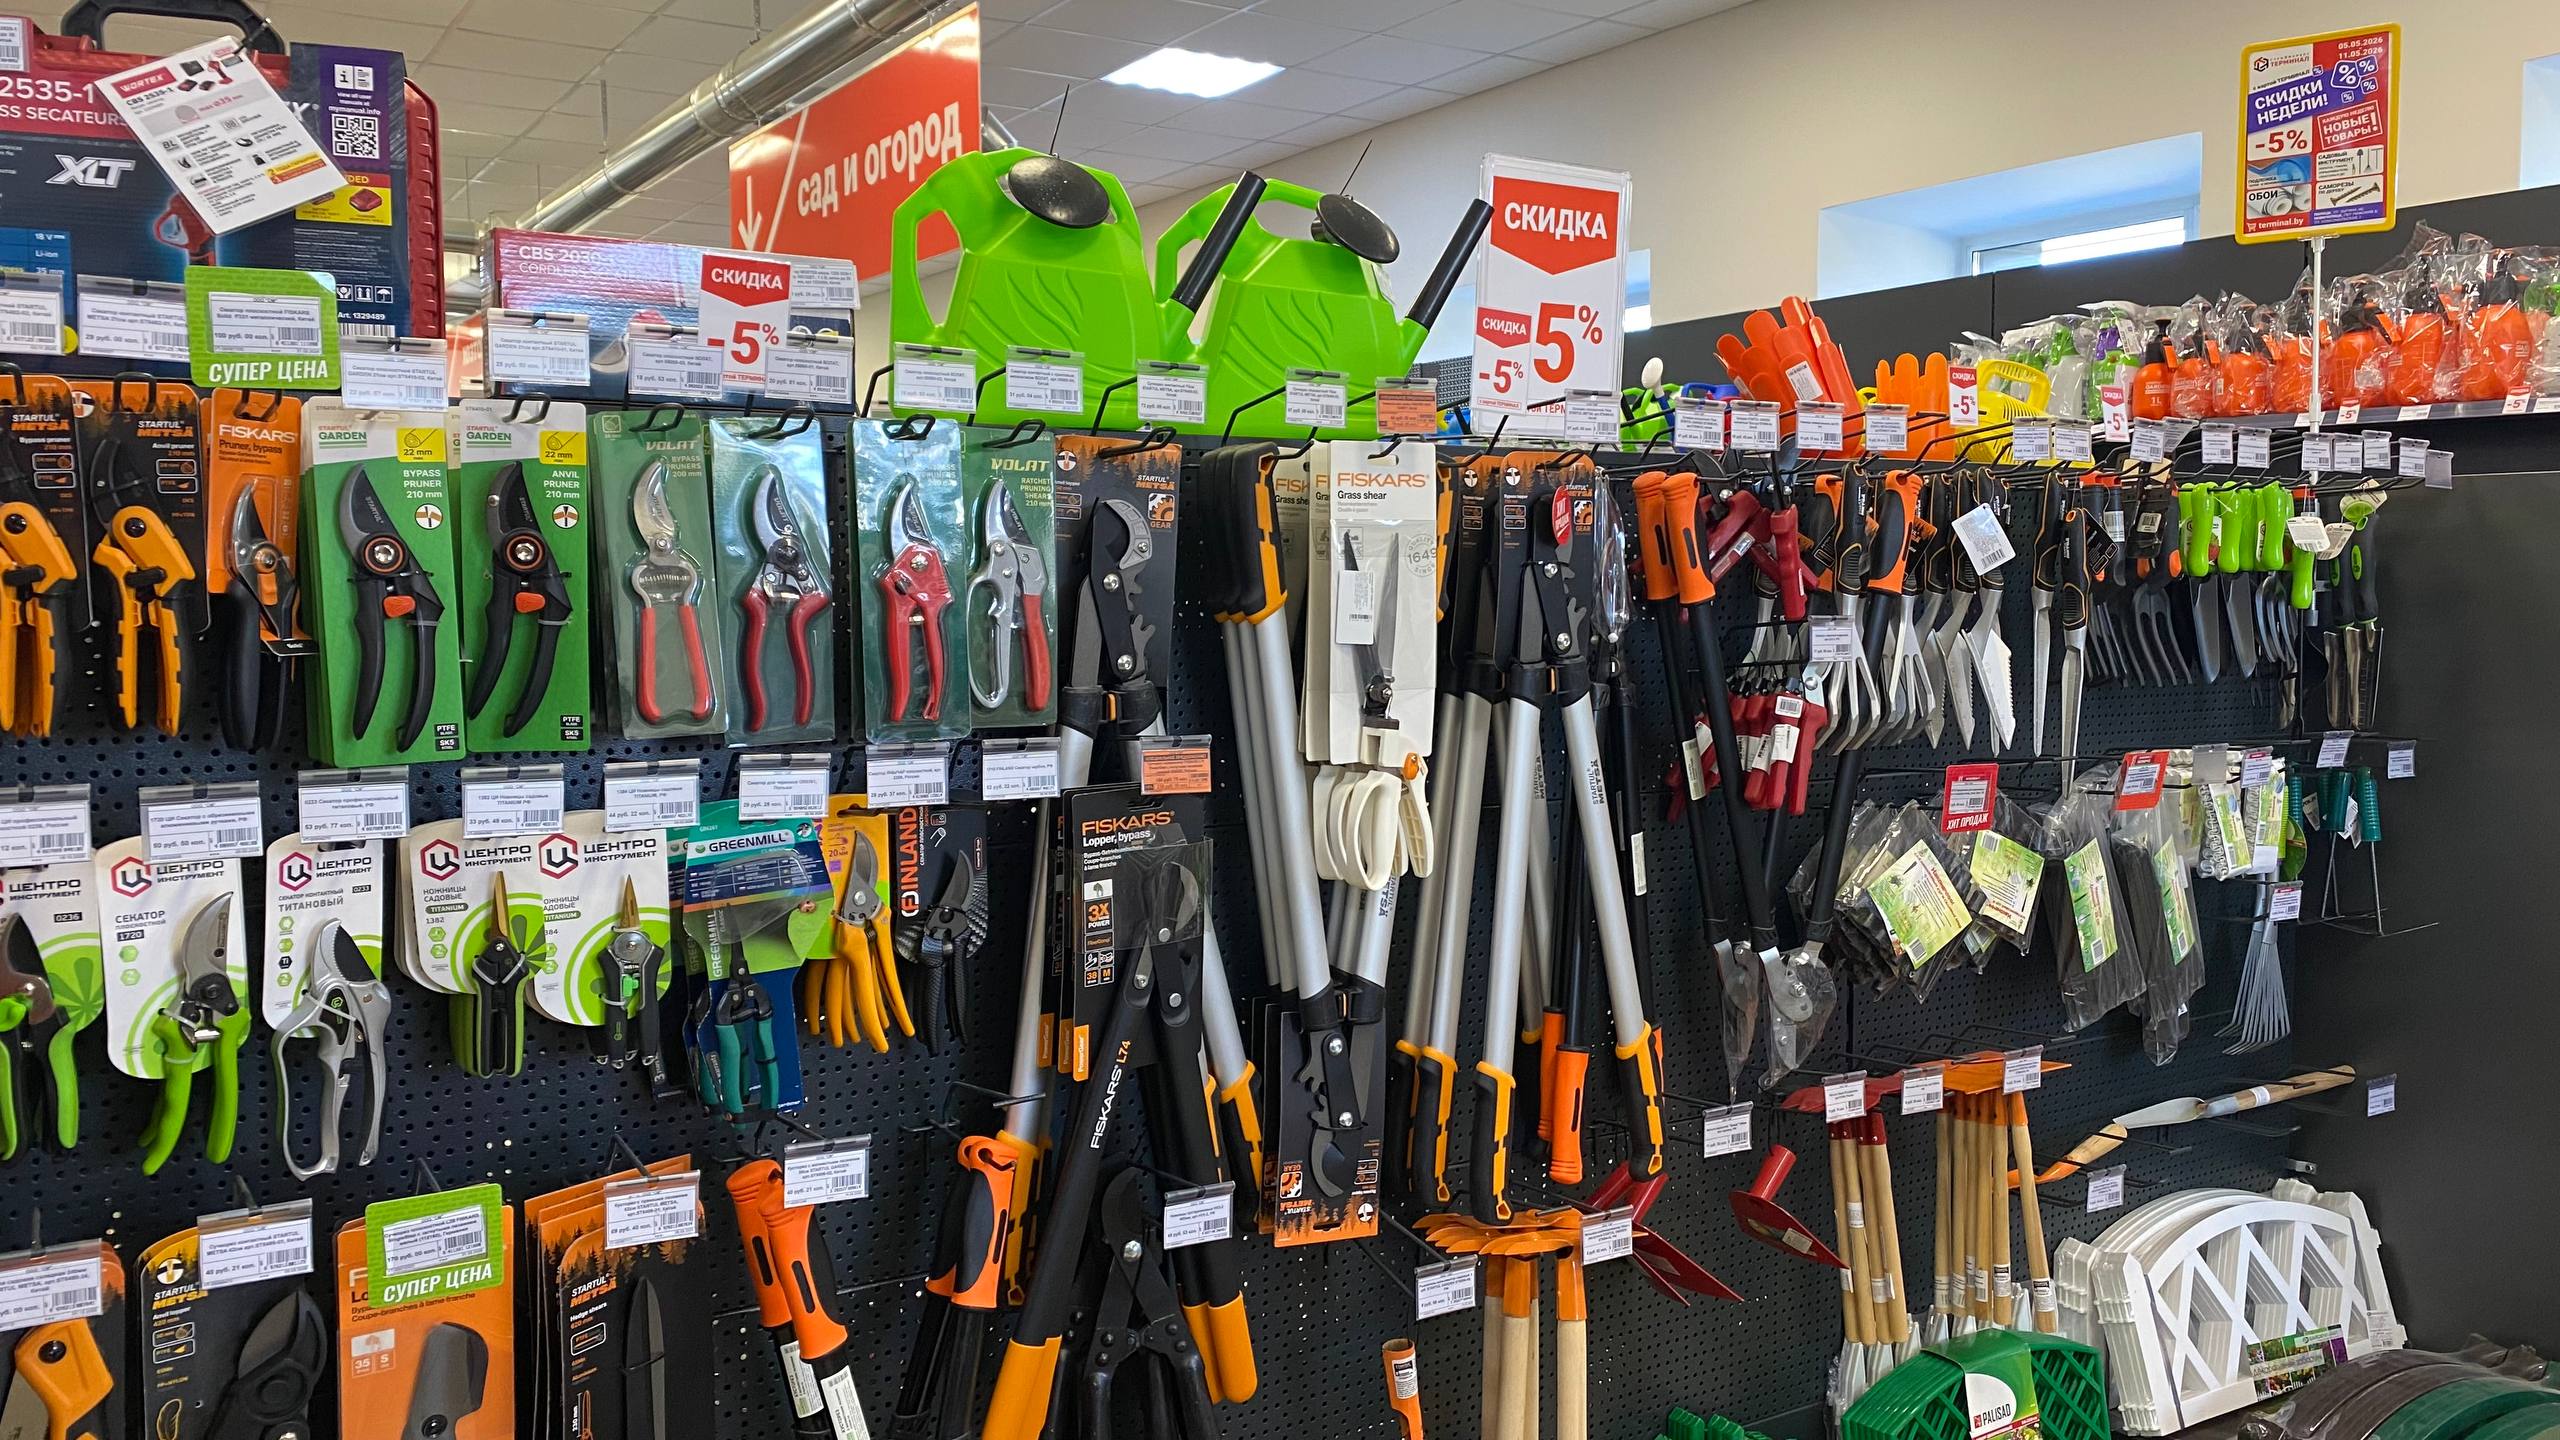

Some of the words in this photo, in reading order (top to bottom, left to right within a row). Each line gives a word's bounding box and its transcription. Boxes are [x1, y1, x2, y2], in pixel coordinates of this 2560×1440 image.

[2338, 36, 2383, 49] 05.05.2026
[2338, 46, 2383, 60] 11.05.2026
[2270, 55, 2310, 67] ТЕРМИНАЛ
[120, 74, 164, 91] WORTEX
[2277, 69, 2310, 84] ТЕРМИНАЛ
[0, 77, 94, 104] 2535-1
[2255, 79, 2323, 110] СКИДКИ
[2257, 93, 2328, 125] НЕДЕЛИ!
[2323, 115, 2369, 135] НОВЫЕ
[2255, 129, 2307, 153] -5%
[797, 169, 840, 217] сад
[842, 156, 859, 196] и
[863, 102, 963, 184] огород
[46, 154, 136, 188] XLT
[2318, 181, 2354, 191] САМОРЕЗЫ
[2248, 190, 2279, 201] ОБОИ
[1504, 202, 1608, 241] СКИДКА
[2258, 217, 2304, 230] terminal.by
[519, 245, 553, 261] CBS
[711, 267, 784, 290] СКИДКА
[338, 311, 350, 319] Art.
[352, 311, 386, 320] 1329489
[1482, 317, 1528, 335] СКИДКА
[707, 320, 780, 364] -5%
[208, 362, 272, 385] СУПЕР
[277, 360, 328, 382] ЦЕНА
[1478, 358, 1524, 393] -5%
[1952, 372, 1976, 381] СКИДКА
[1952, 395, 1976, 415] -5%
[12, 413, 58, 422] STARTUL
[138, 420, 182, 428] STARTUL
[19, 436, 45, 445] Bypass
[46, 436, 71, 444] pruner
[218, 424, 297, 444] FISKARS
[318, 431, 368, 440] GARDEN
[466, 431, 512, 441] GARDEN
[218, 438, 252, 451] Pruner,
[252, 441, 283, 455] bypass
[403, 448, 414, 456] 22
[646, 440, 698, 451] VOLAT
[544, 450, 556, 458] 22
[671, 455, 701, 463] BYPASS
[668, 462, 702, 470] PRUNERS
[991, 458, 1050, 472] VOLAT
[403, 469, 441, 477] BYPASS
[551, 470, 580, 478] ANVIL
[403, 479, 442, 488] PRUNER
[543, 480, 580, 489] PRUNER
[1021, 477, 1051, 485] RATCHET
[1275, 478, 1309, 493] FISK
[1337, 473, 1426, 488] FISKARS
[406, 490, 424, 499] 210
[545, 490, 562, 498] 210
[563, 491, 580, 499] mm
[1024, 492, 1052, 500] SHEARS
[1337, 490, 1364, 501] Grass
[1365, 490, 1387, 501] shear
[774, 497, 789, 522] VOLAT
[1009, 508, 1024, 532] VOLAT
[1408, 547, 1437, 565] 1649
[562, 715, 581, 723] PTFE
[436, 723, 455, 732] PTFE
[563, 729, 580, 737] SK5
[439, 739, 455, 747] SK5
[1592, 768, 1602, 805] STARTUL
[1082, 811, 1170, 836] FISKARS
[1946, 818, 1959, 831] ХИТ
[1960, 812, 1989, 828] ПРОДАЖ
[709, 832, 788, 852] GREENMILL
[1083, 831, 1117, 848] Lopper,
[1118, 828, 1151, 842] bypass
[464, 845, 532, 859] ЦЕНТРО
[584, 838, 657, 854] ЦЕНТРО
[584, 850, 657, 863] ИНСТРУМЕНТ
[828, 850, 839, 858] 20
[156, 861, 224, 875] ЦЕНТРО
[316, 857, 372, 870] ЦЕНТРО
[465, 856, 532, 867] ИНСТРУМЕНТ
[157, 870, 225, 884] ИНСТРУМЕНТ
[316, 867, 372, 878] ИНСТРУМЕНТ
[9, 879, 81, 893] ЦЕНТРО
[423, 885, 467, 896] НОЖНИЦЫ
[10, 890, 81, 901] ИНСТРУМЕНТ
[278, 892, 305, 901] СЕКАТОР
[305, 888, 344, 898] КОНТАКТНЫЙ
[423, 893, 463, 903] САДОВЫЕ
[543, 895, 580, 905] ОЖНИЦЫ
[278, 896, 344, 913] ТИТАНОВЫЙ
[430, 903, 465, 912] TITANIUM
[543, 902, 576, 912] АДОВЫЕ
[55, 912, 81, 922] 0236
[115, 909, 166, 924] СЕКАТОР
[544, 912, 578, 921] TITANIUM
[1088, 903, 1110, 921] 3X
[426, 916, 445, 924] 1382
[1088, 919, 1111, 929] POWER
[118, 930, 143, 941] 1720
[706, 909, 723, 978] GREENMILL
[1086, 971, 1098, 980] 38
[1102, 967, 1111, 977] M
[1077, 1032, 1086, 1074] PowerGear
[1116, 1040, 1131, 1064] L74
[1090, 1068, 1122, 1149] FISKARS
[1283, 1164, 1301, 1172] GEAR
[1286, 1206, 1311, 1214] STARTUL
[383, 1275, 441, 1303] СУПЕР
[445, 1263, 493, 1289] ЦЕНА
[571, 1275, 607, 1298] STARTUL
[154, 1284, 197, 1301] STARTUL
[570, 1310, 588, 1322] Hedge
[588, 1302, 607, 1316] shears
[354, 1358, 371, 1369] 35
[380, 1353, 389, 1363] S
[1982, 1403, 2011, 1426] PALISAD
